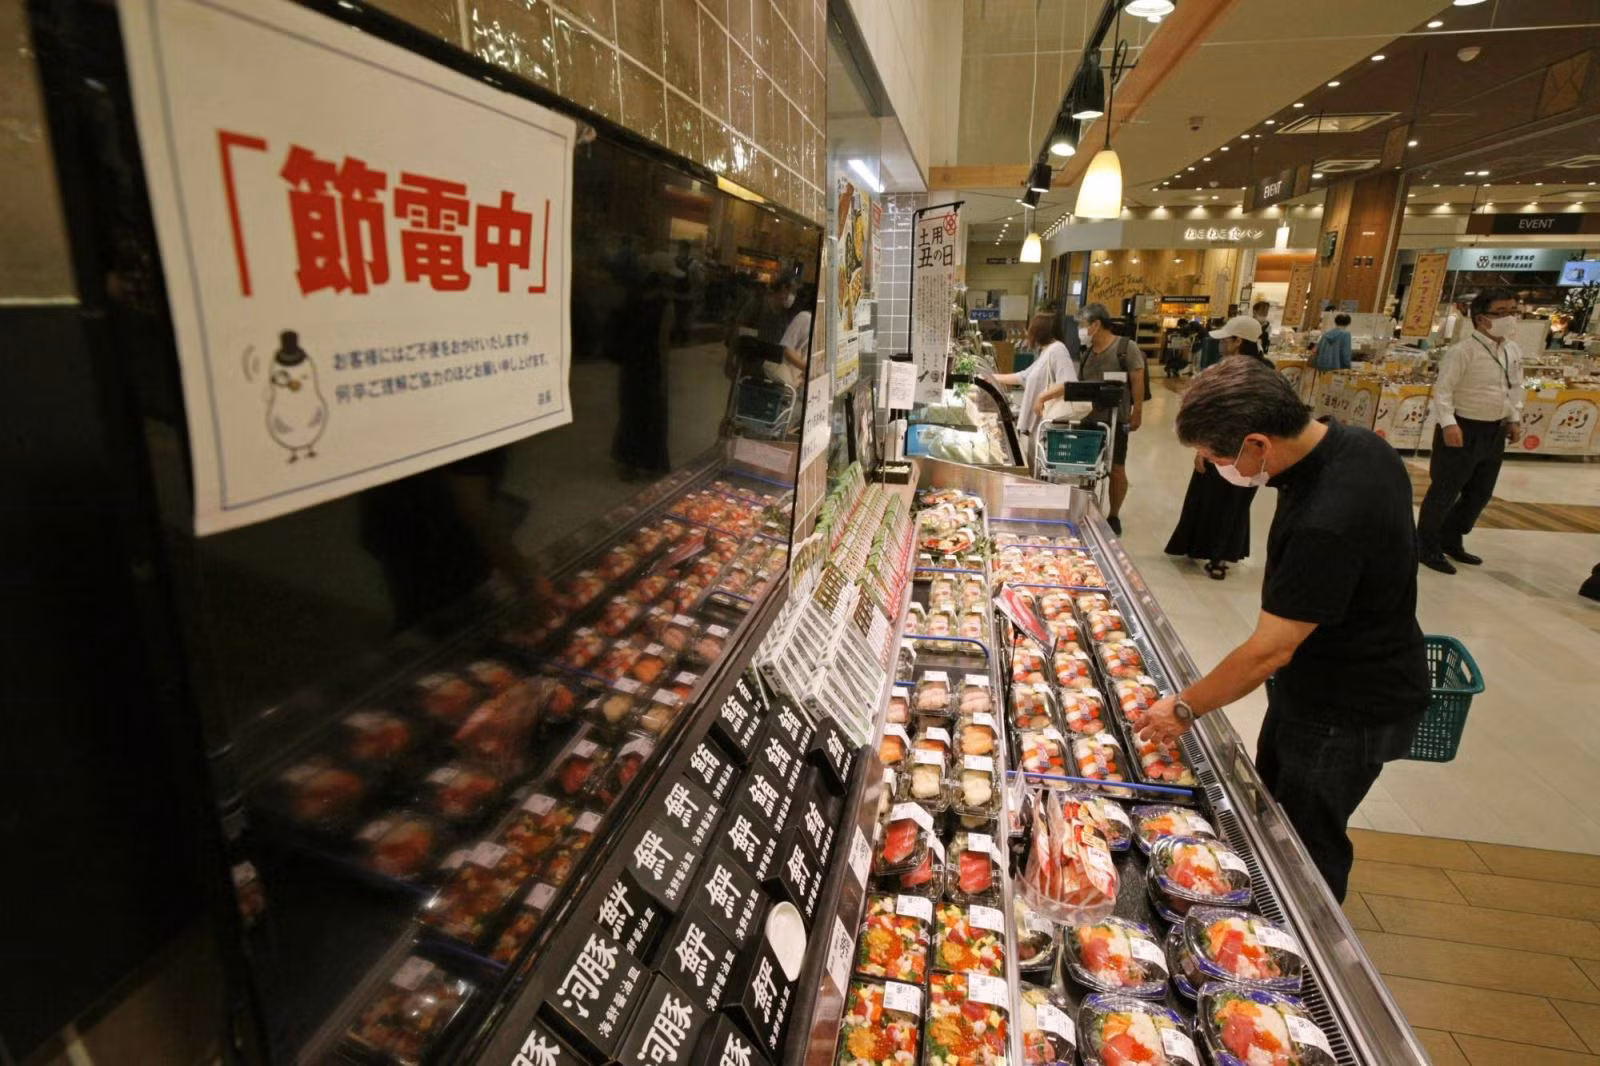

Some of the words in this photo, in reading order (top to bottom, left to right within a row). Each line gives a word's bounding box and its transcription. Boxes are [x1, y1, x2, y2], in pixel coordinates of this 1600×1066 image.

[1263, 180, 1282, 199] EVENT
[216, 129, 551, 298] 「節電中」
[1518, 219, 1555, 229] EVENT
[918, 226, 943, 247] 土用
[1184, 226, 1264, 241] ねこねこ食パン
[917, 244, 953, 269] 丑の日
[333, 332, 529, 371] お客様にはご不便をおかけいたしますが
[556, 933, 619, 1018] 河豚
